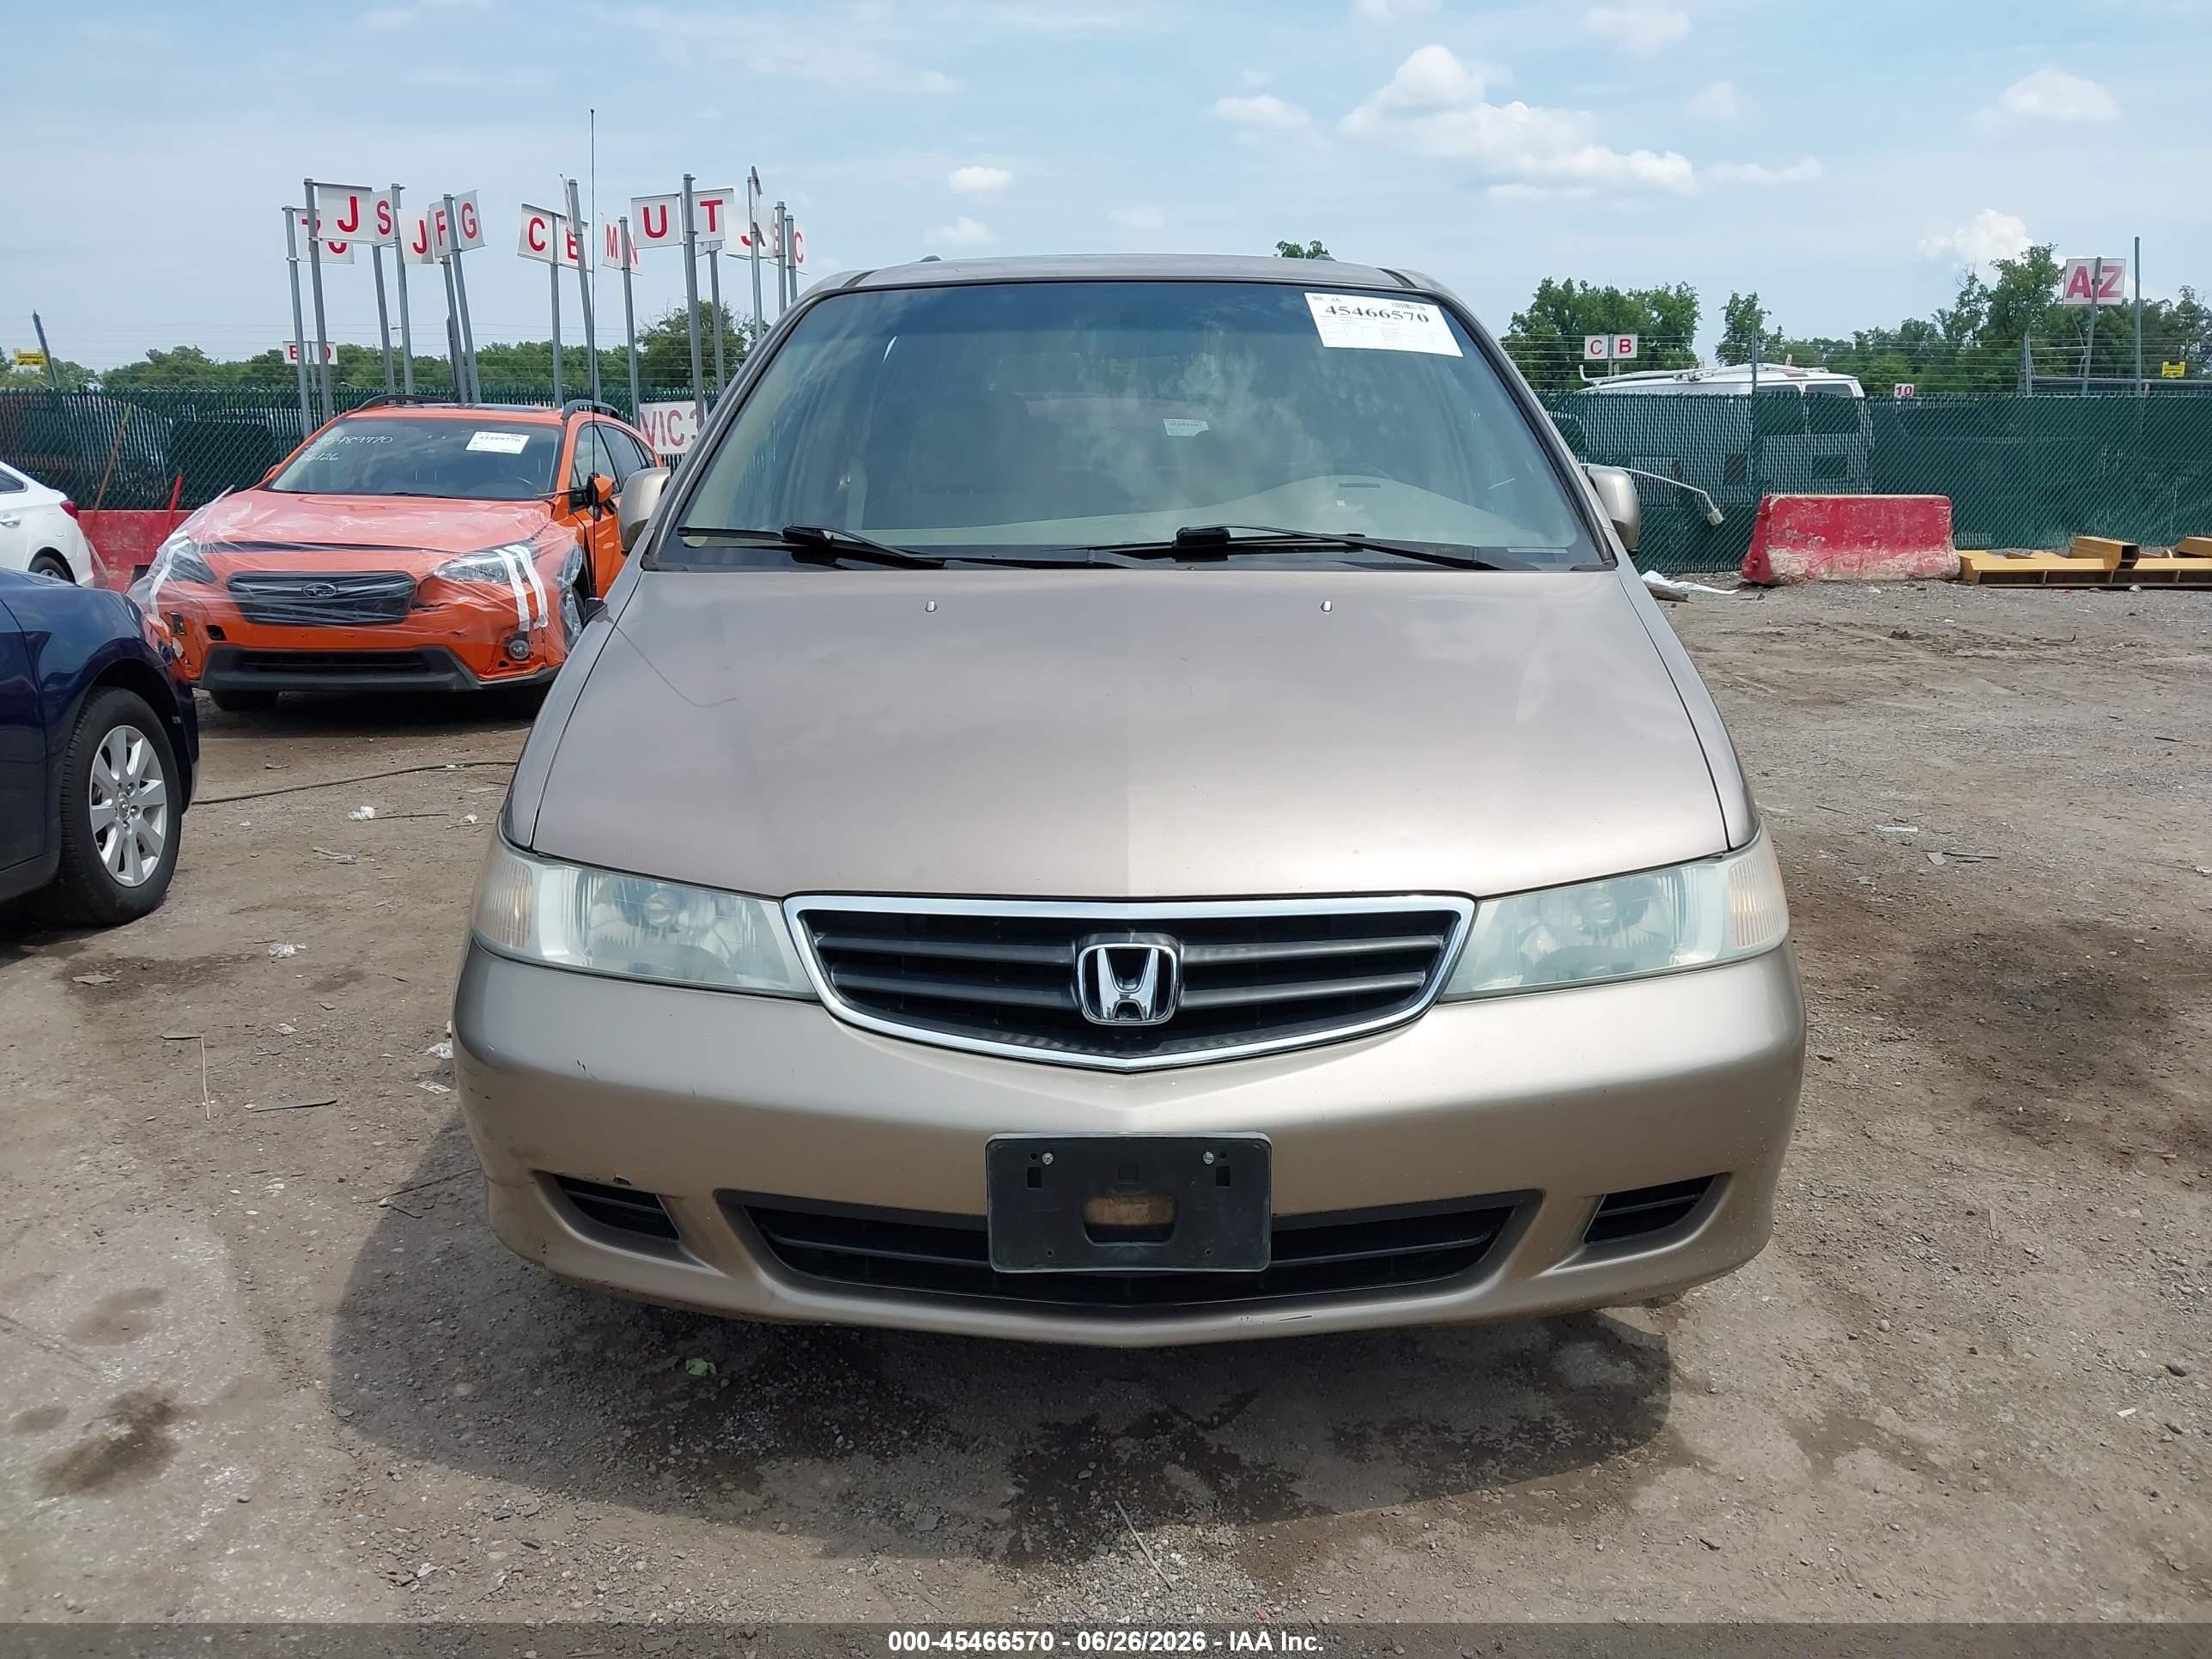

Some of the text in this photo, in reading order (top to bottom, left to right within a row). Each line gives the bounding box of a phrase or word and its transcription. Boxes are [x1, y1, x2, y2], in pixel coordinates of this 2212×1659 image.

[337, 196, 358, 233] J
[376, 200, 392, 235] S
[434, 202, 477, 246] F G
[642, 198, 723, 239] U T
[412, 219, 428, 254] J
[528, 216, 546, 252] C
[606, 224, 618, 259] M
[793, 231, 805, 264] C
[1325, 305, 1430, 324] 45466570
[1589, 338, 1632, 356] C B
[1895, 385, 1913, 396] 10
